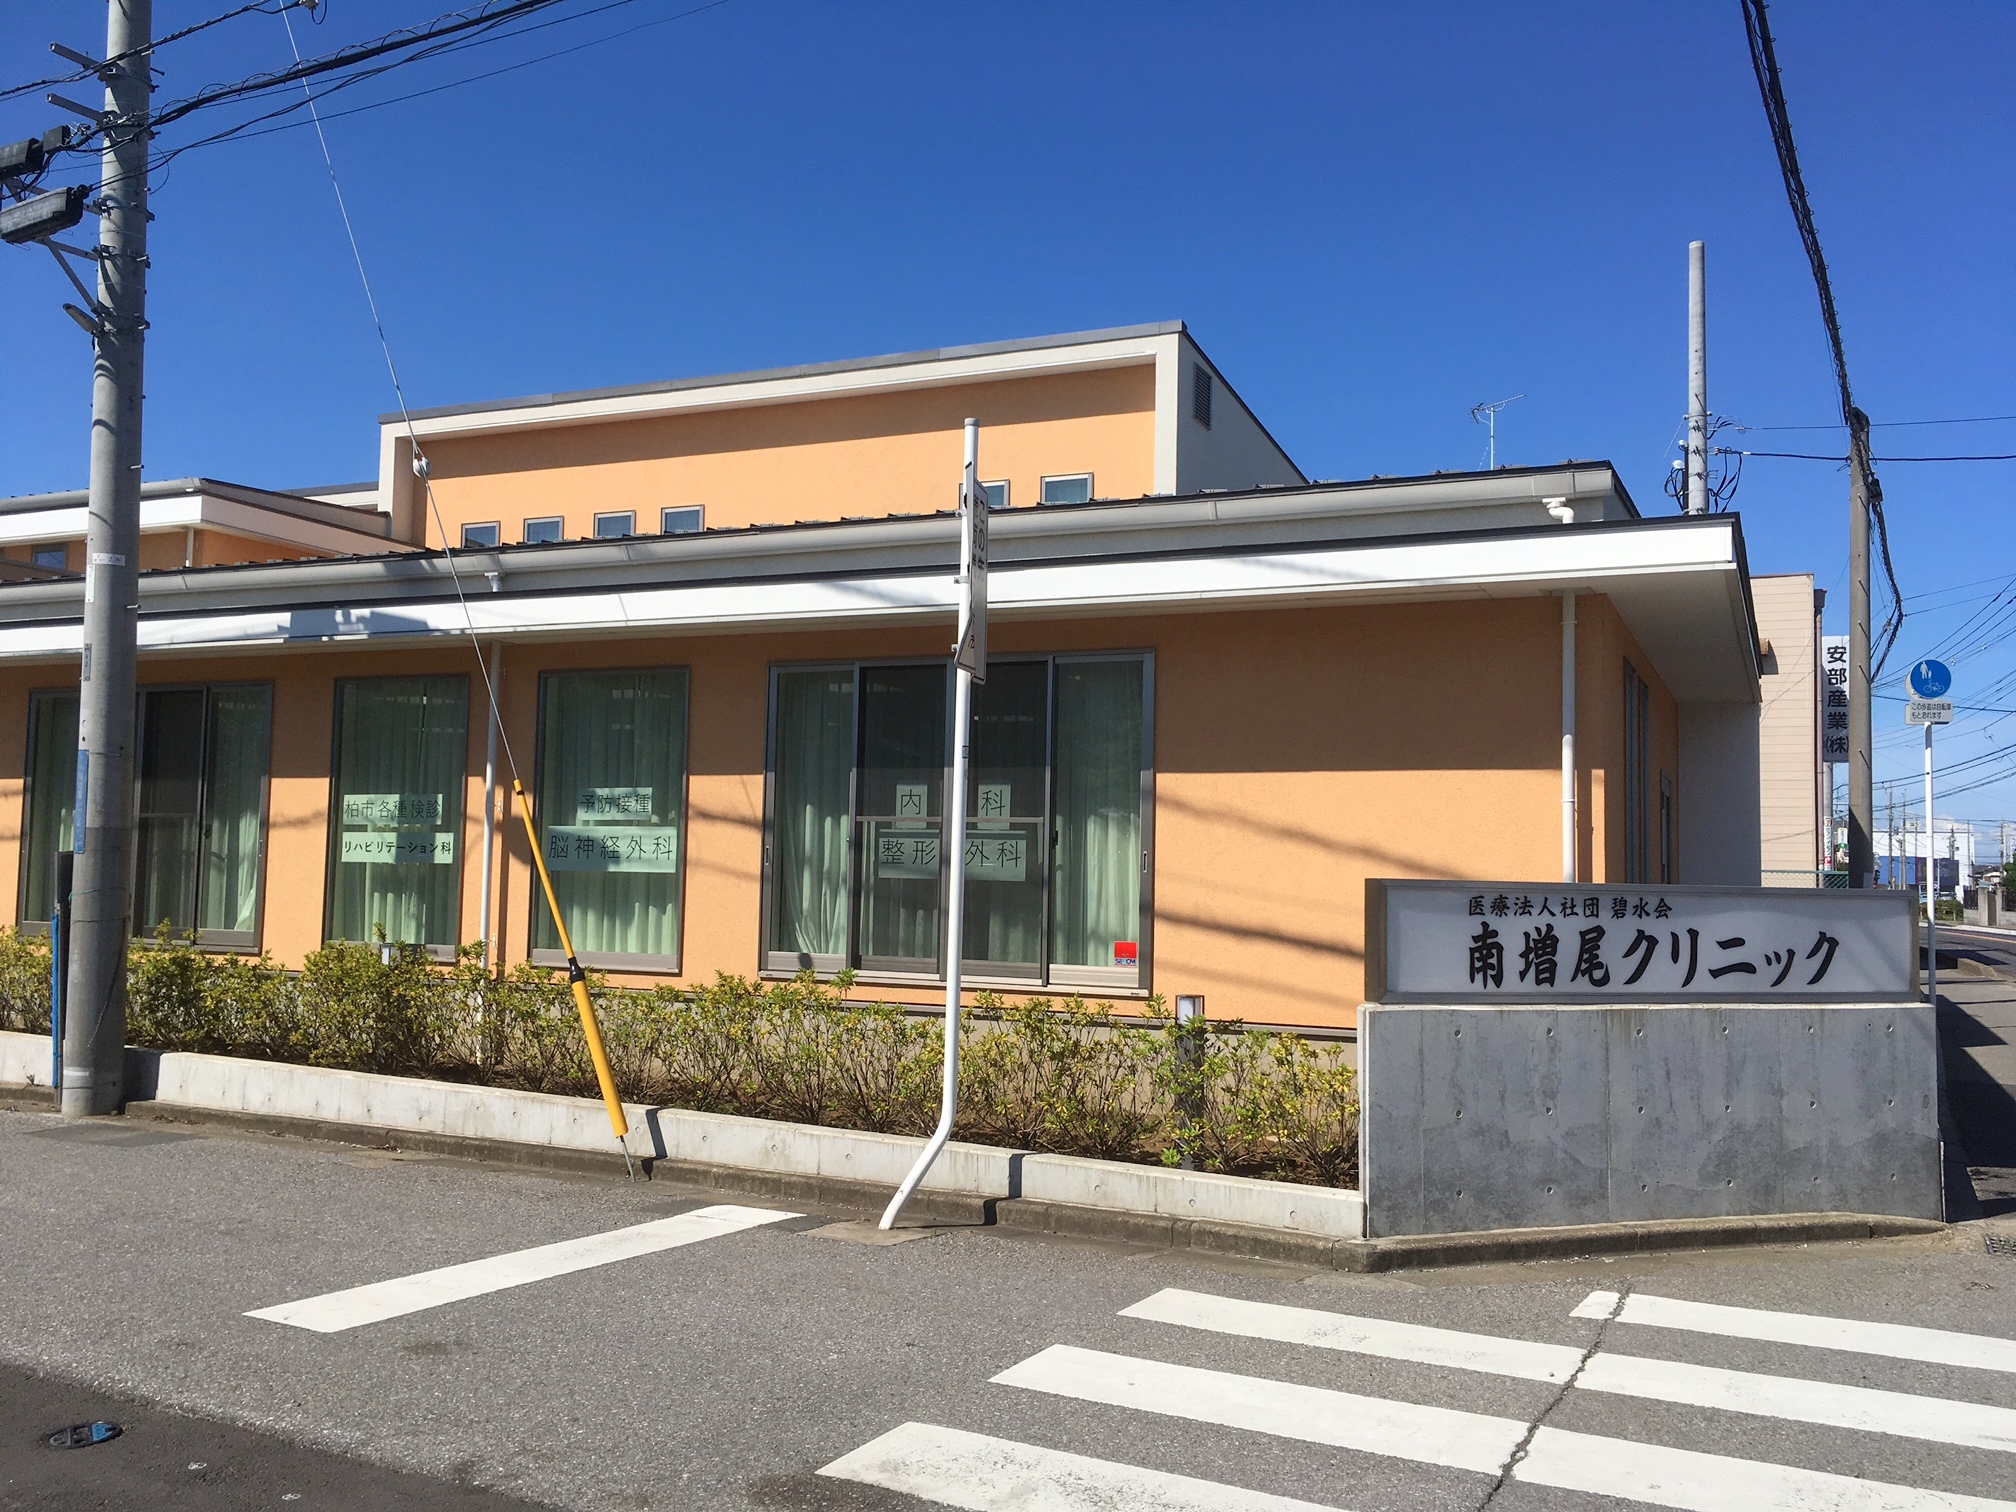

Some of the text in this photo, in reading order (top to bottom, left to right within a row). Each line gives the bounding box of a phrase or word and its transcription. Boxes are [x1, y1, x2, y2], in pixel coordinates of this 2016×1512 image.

[344, 799, 441, 819] 柏市各種検診
[580, 793, 651, 815] 予防接種
[344, 841, 452, 855] リハビリテーション科
[549, 834, 673, 860] 脳神経外科
[1468, 921, 1841, 990] 南増尾クリニック
